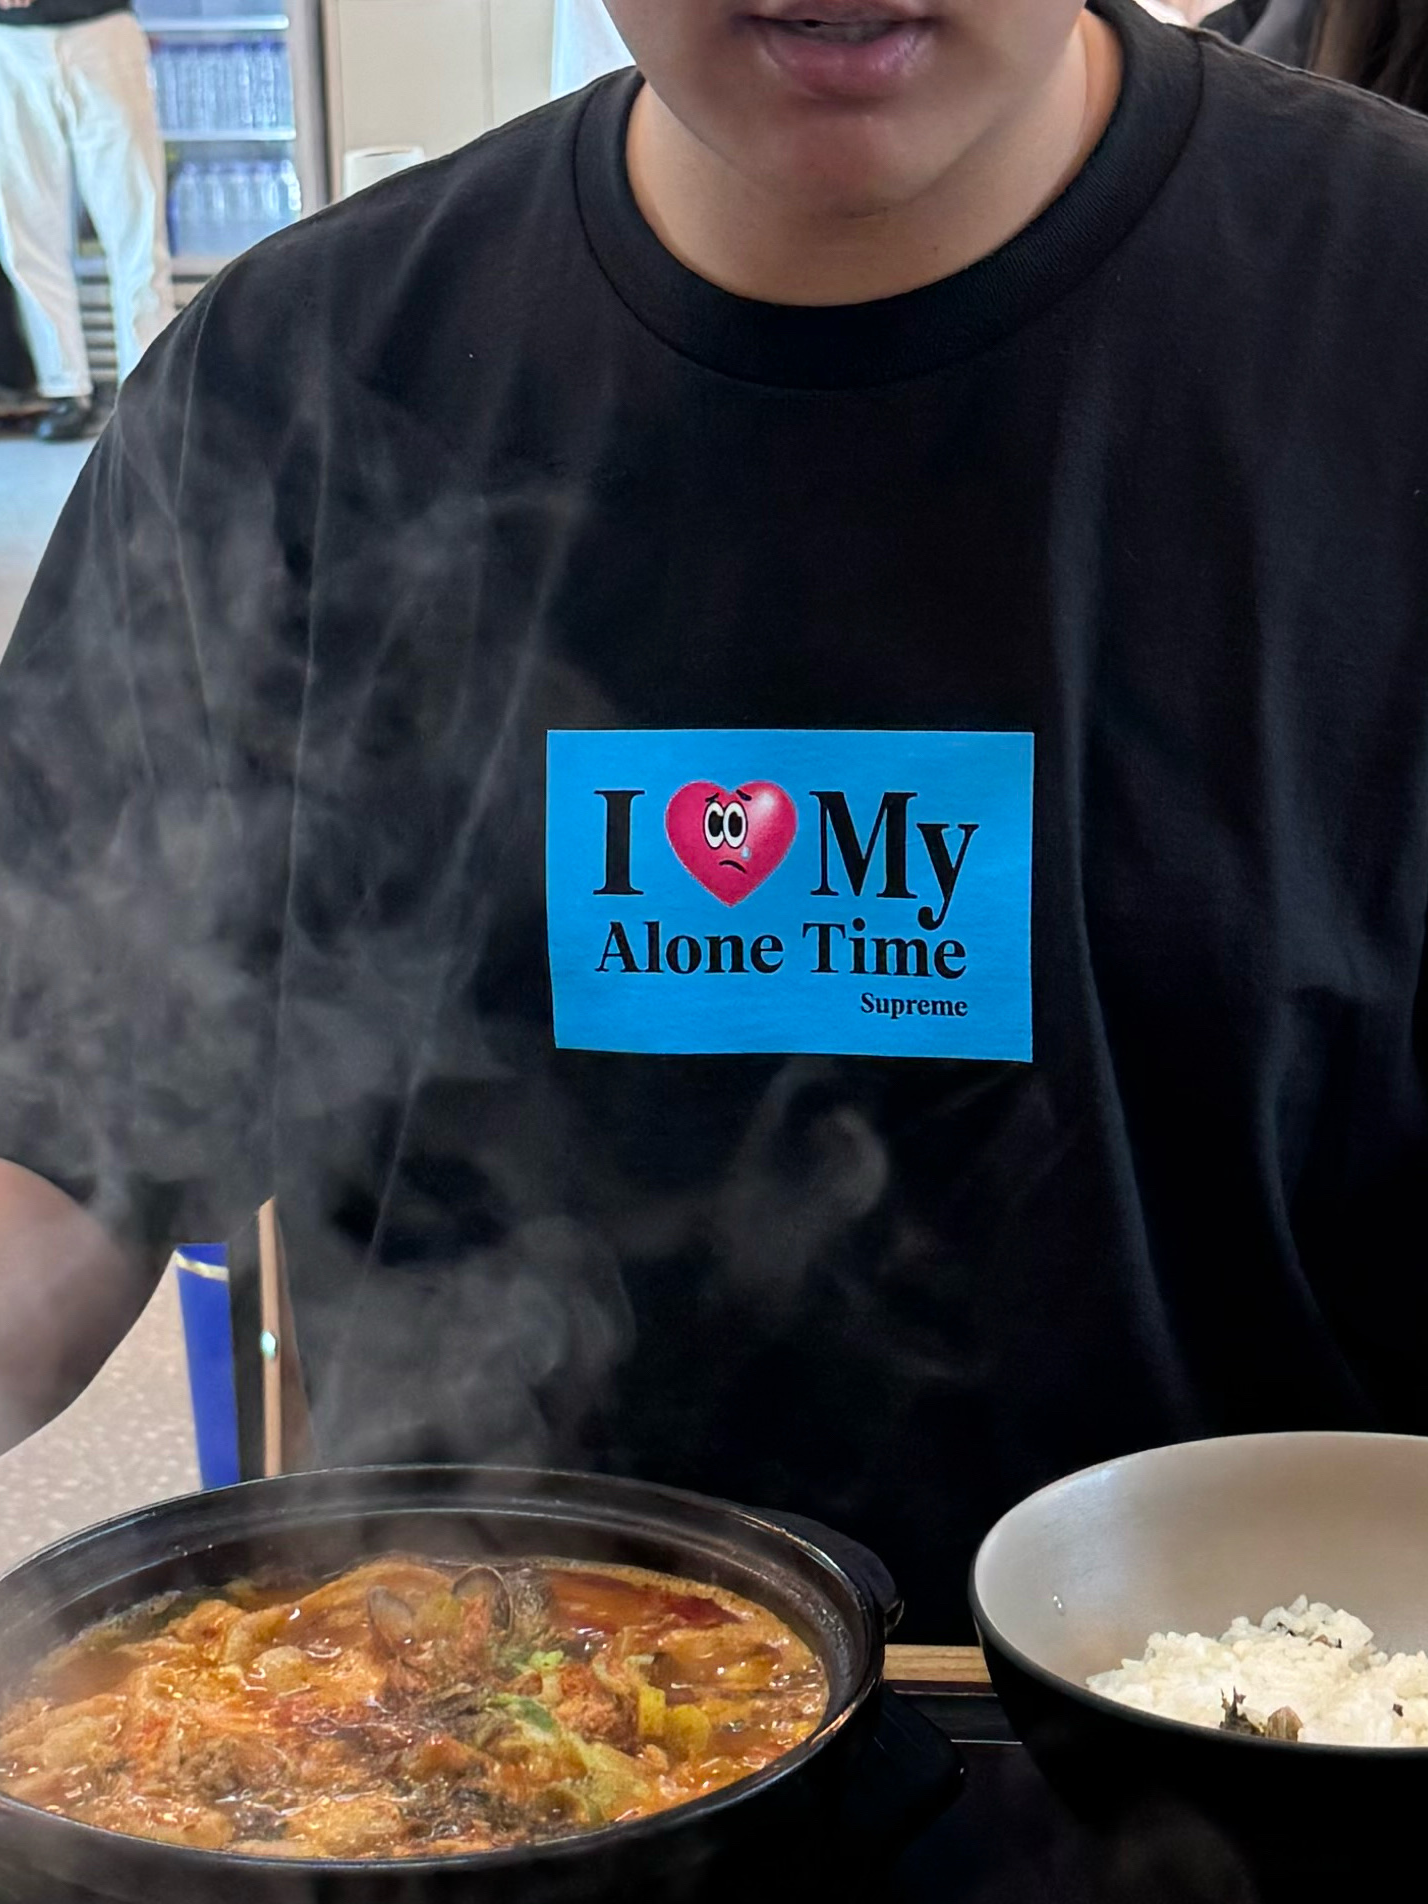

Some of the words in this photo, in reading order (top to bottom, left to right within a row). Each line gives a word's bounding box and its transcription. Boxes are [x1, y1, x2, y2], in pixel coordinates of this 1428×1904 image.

[593, 790, 645, 896] I
[809, 791, 979, 931] My
[595, 920, 784, 974] Alone
[802, 917, 968, 979] Time
[860, 991, 969, 1019] Supreme
